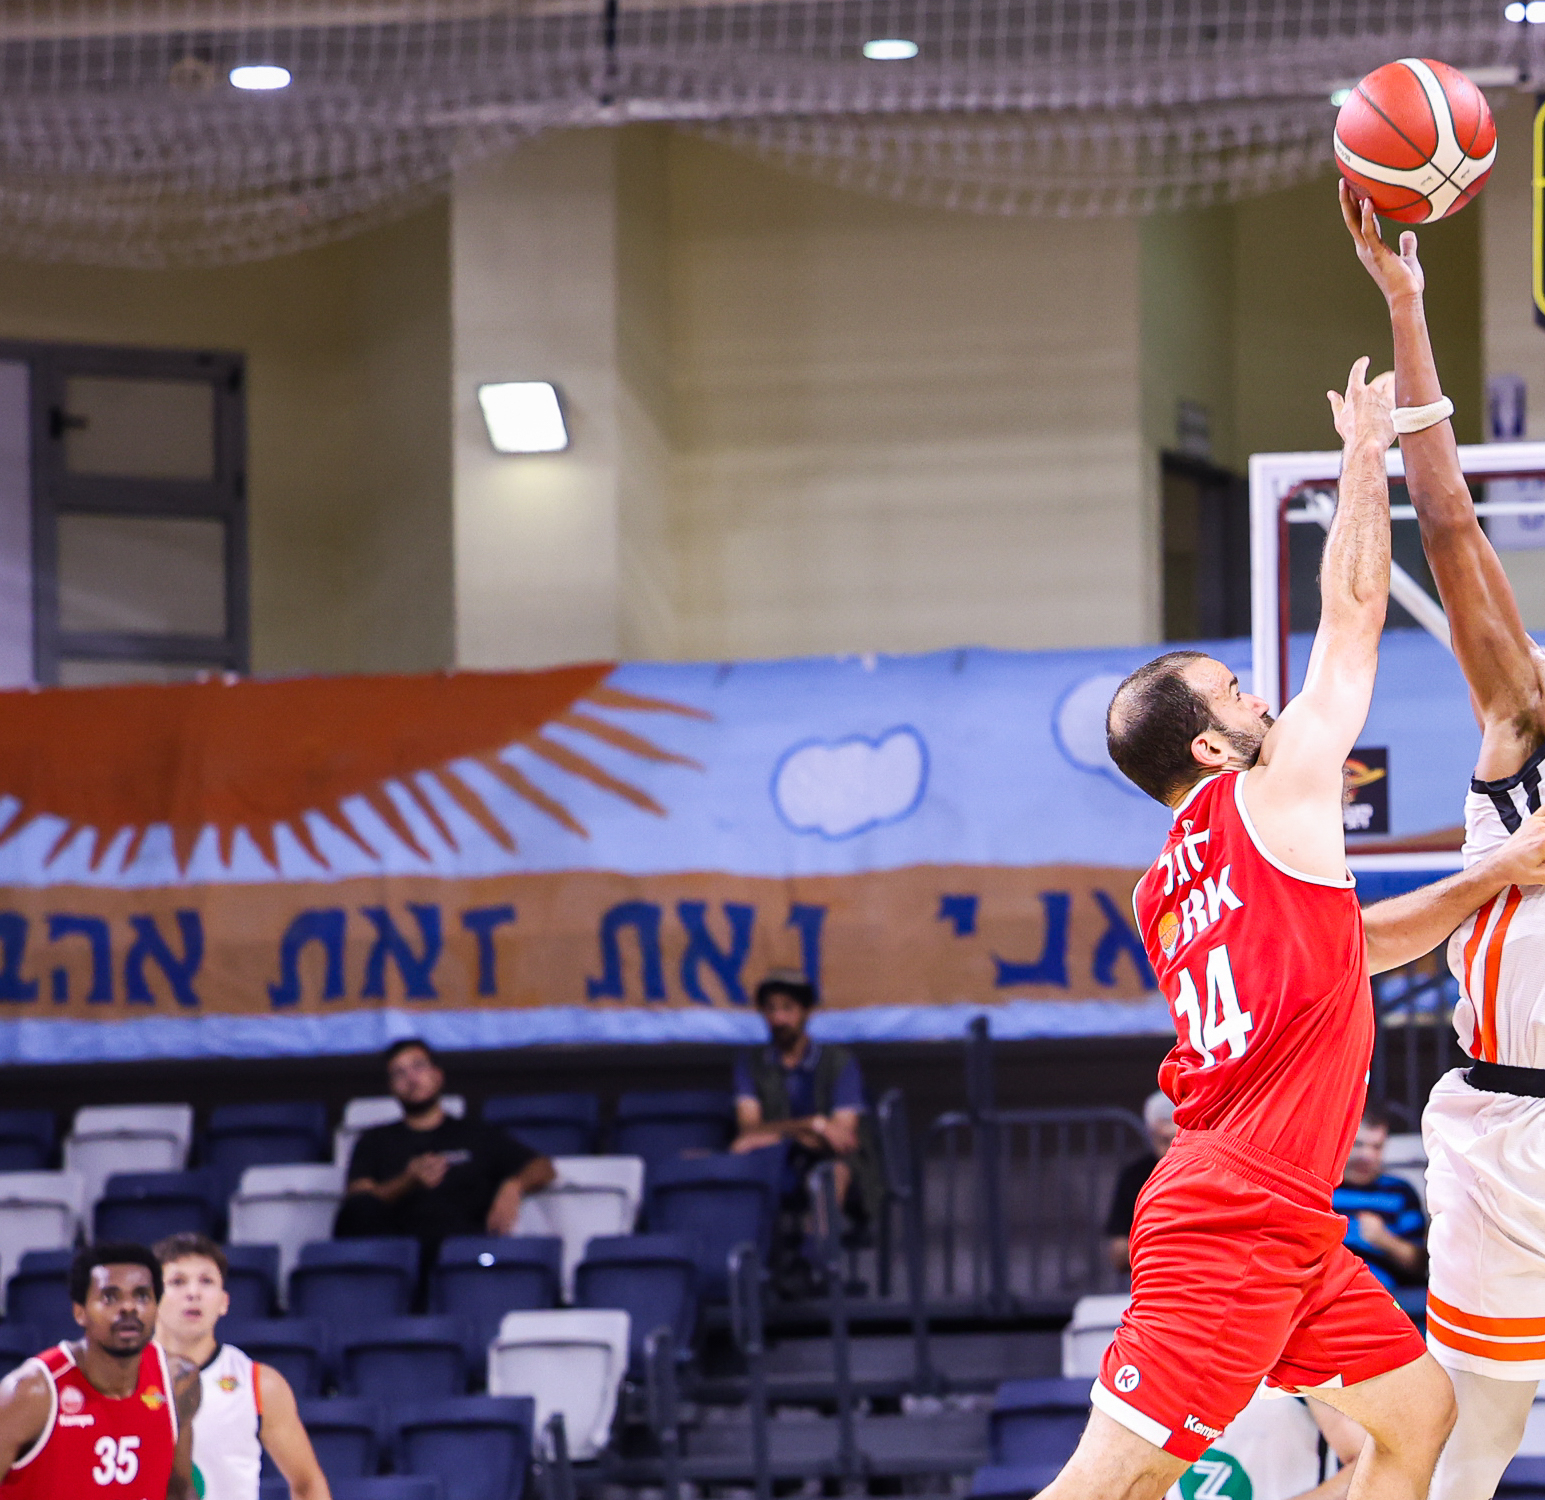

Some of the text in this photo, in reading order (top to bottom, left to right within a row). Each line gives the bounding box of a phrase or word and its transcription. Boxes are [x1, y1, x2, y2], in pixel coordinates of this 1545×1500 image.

[268, 902, 518, 1008] זאת
[1174, 944, 1254, 1069] 14
[92, 1435, 141, 1486] 35
